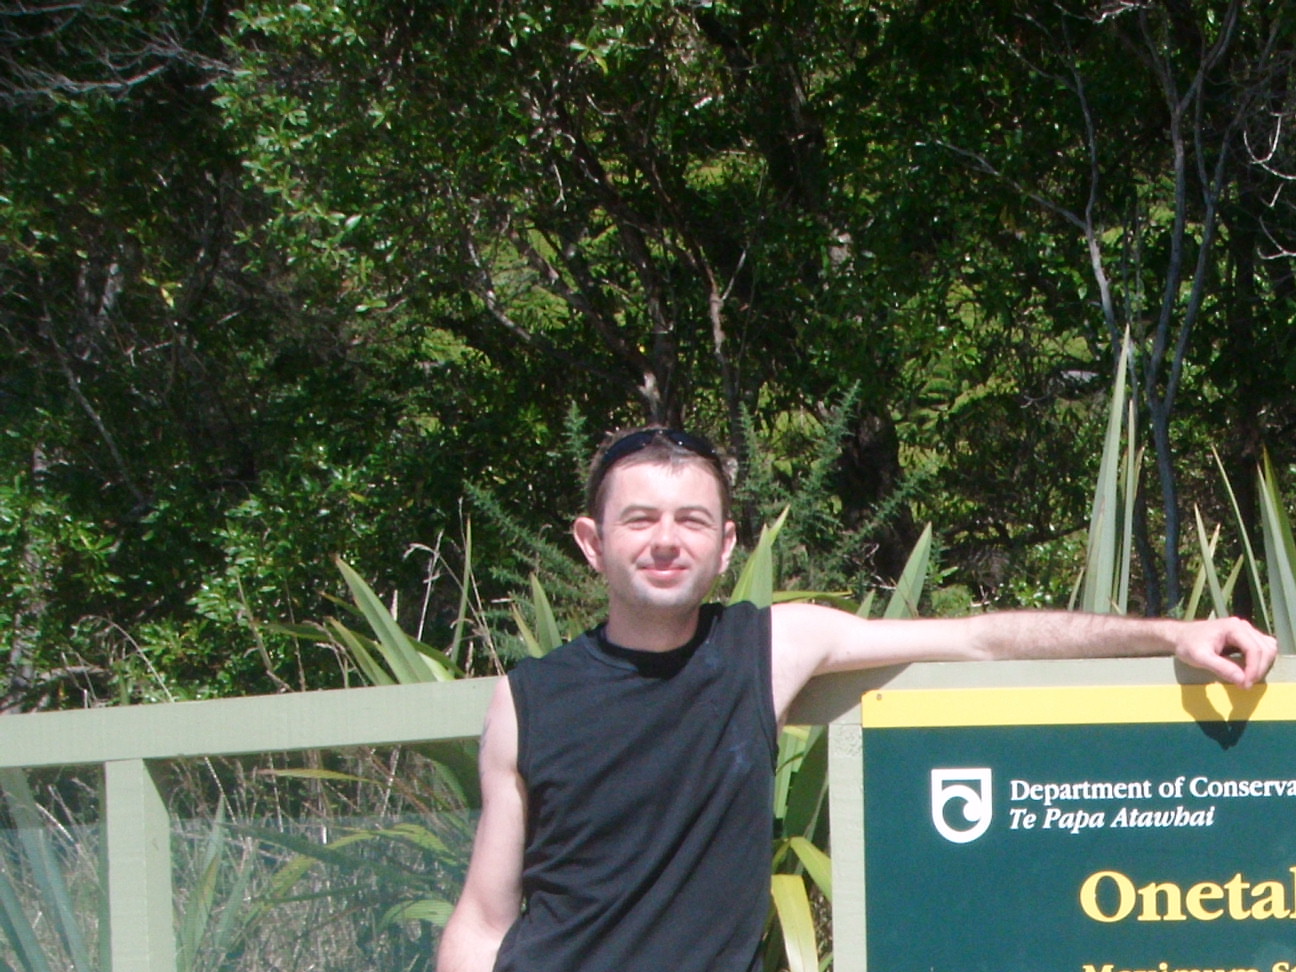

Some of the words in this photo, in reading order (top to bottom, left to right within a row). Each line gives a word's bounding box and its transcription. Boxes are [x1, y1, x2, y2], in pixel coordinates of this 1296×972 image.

[1010, 779, 1152, 804] Department
[1158, 776, 1185, 798] of
[1010, 808, 1036, 829] Te
[1042, 807, 1105, 834] Papa
[1110, 805, 1215, 827] Atawhai
